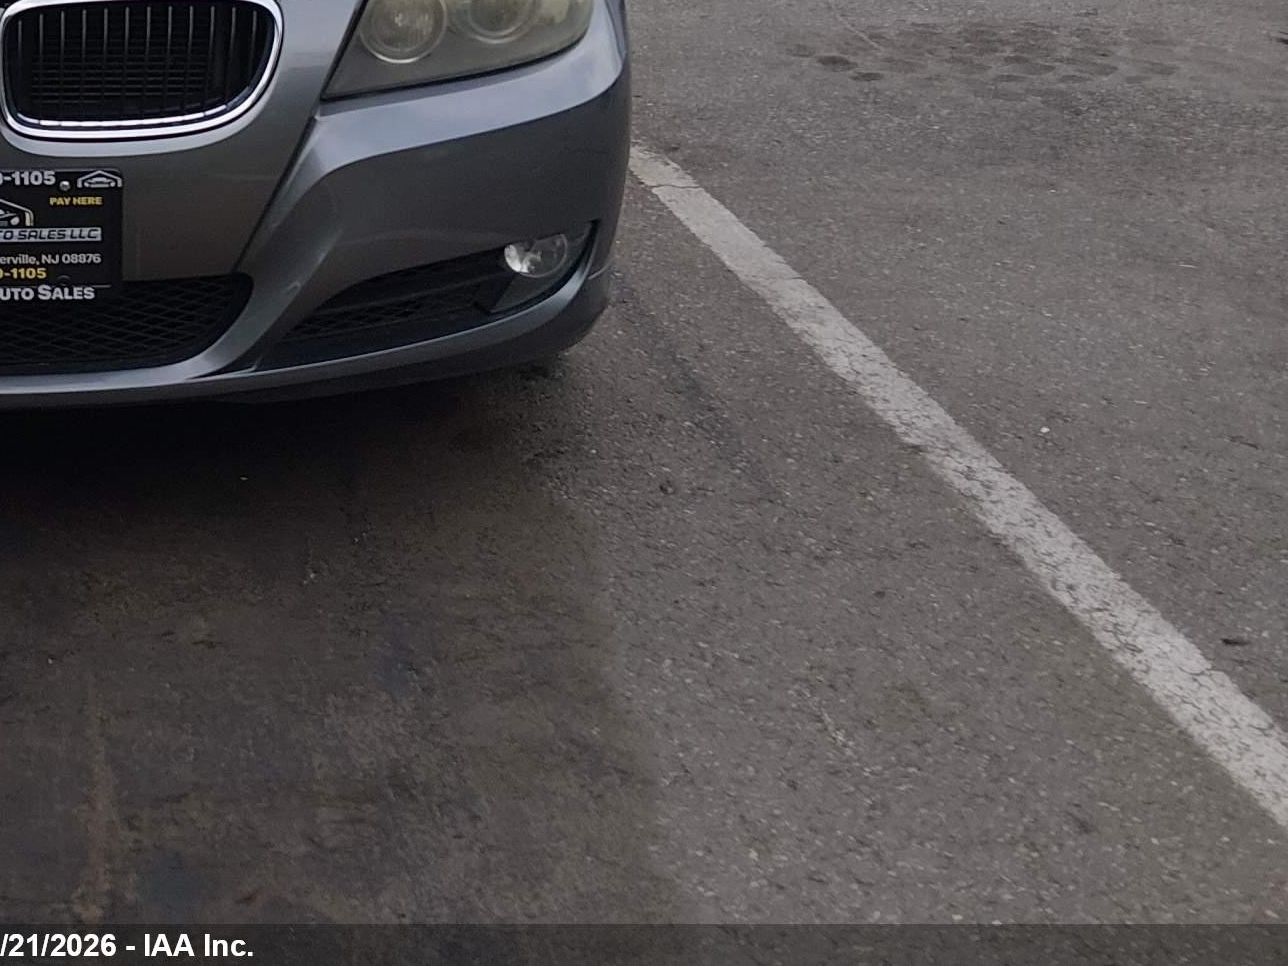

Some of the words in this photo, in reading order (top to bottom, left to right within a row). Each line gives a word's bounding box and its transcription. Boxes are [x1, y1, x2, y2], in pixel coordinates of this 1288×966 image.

[49, 197, 71, 205] PAY
[72, 196, 103, 205] HERE
[17, 229, 66, 240] SALES
[69, 228, 100, 239] LLC
[41, 254, 60, 264] NJ
[61, 253, 102, 264] 08876
